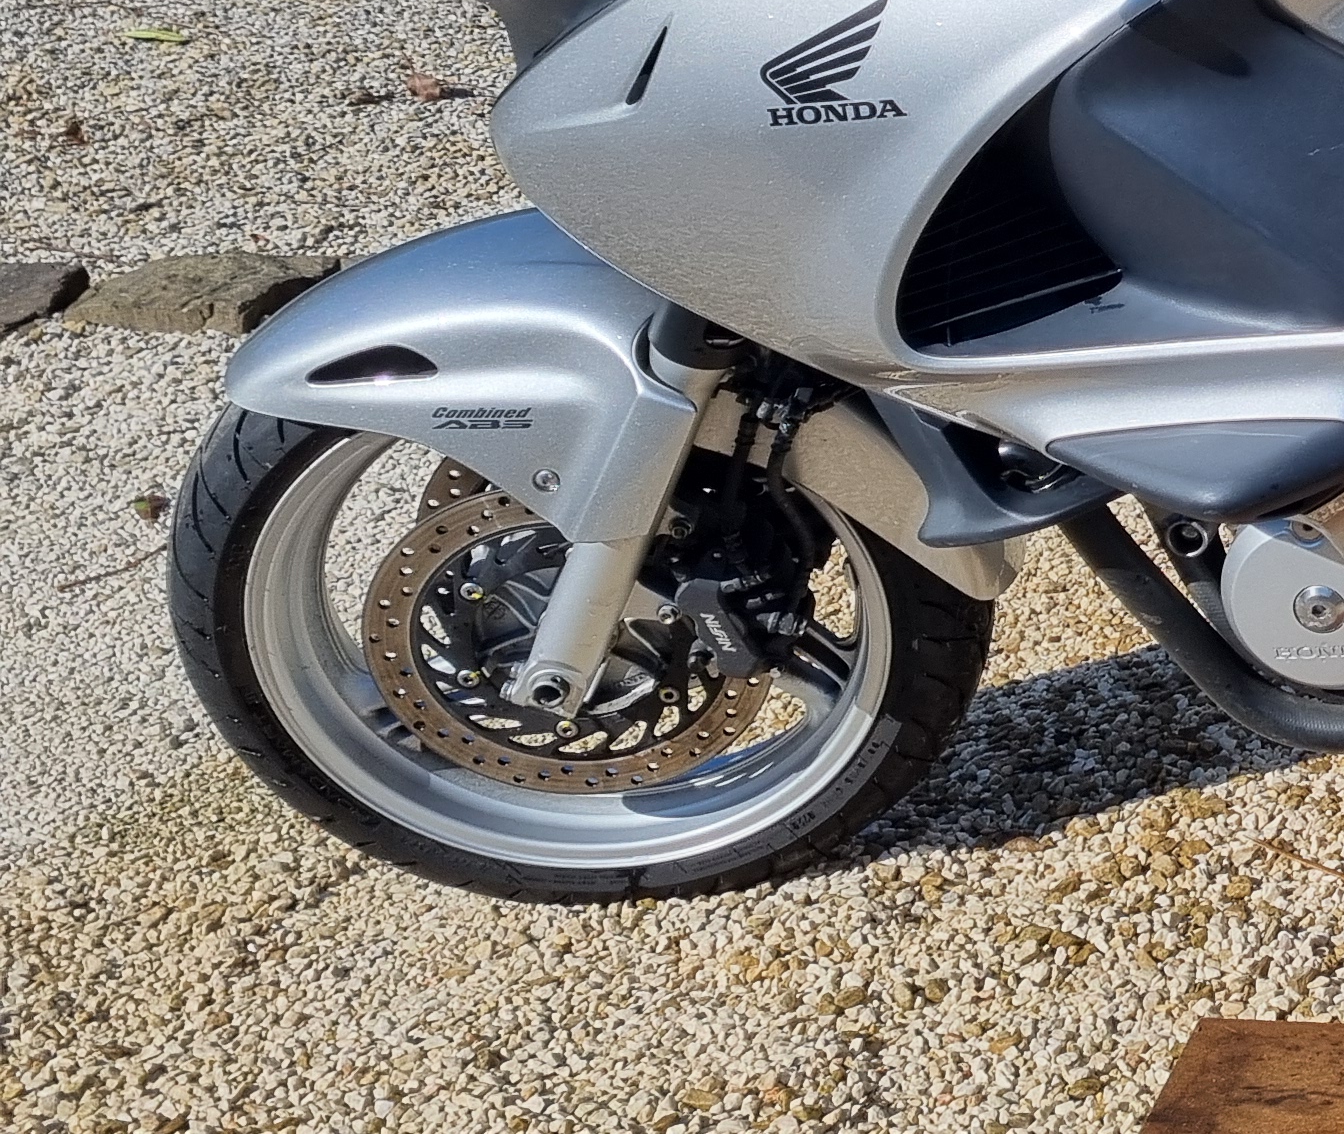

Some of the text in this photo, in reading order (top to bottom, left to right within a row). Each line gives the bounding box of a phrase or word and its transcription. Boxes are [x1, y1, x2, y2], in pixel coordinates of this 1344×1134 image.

[767, 99, 908, 127] HONDA
[431, 407, 533, 419] Combined
[431, 419, 533, 430] ABS
